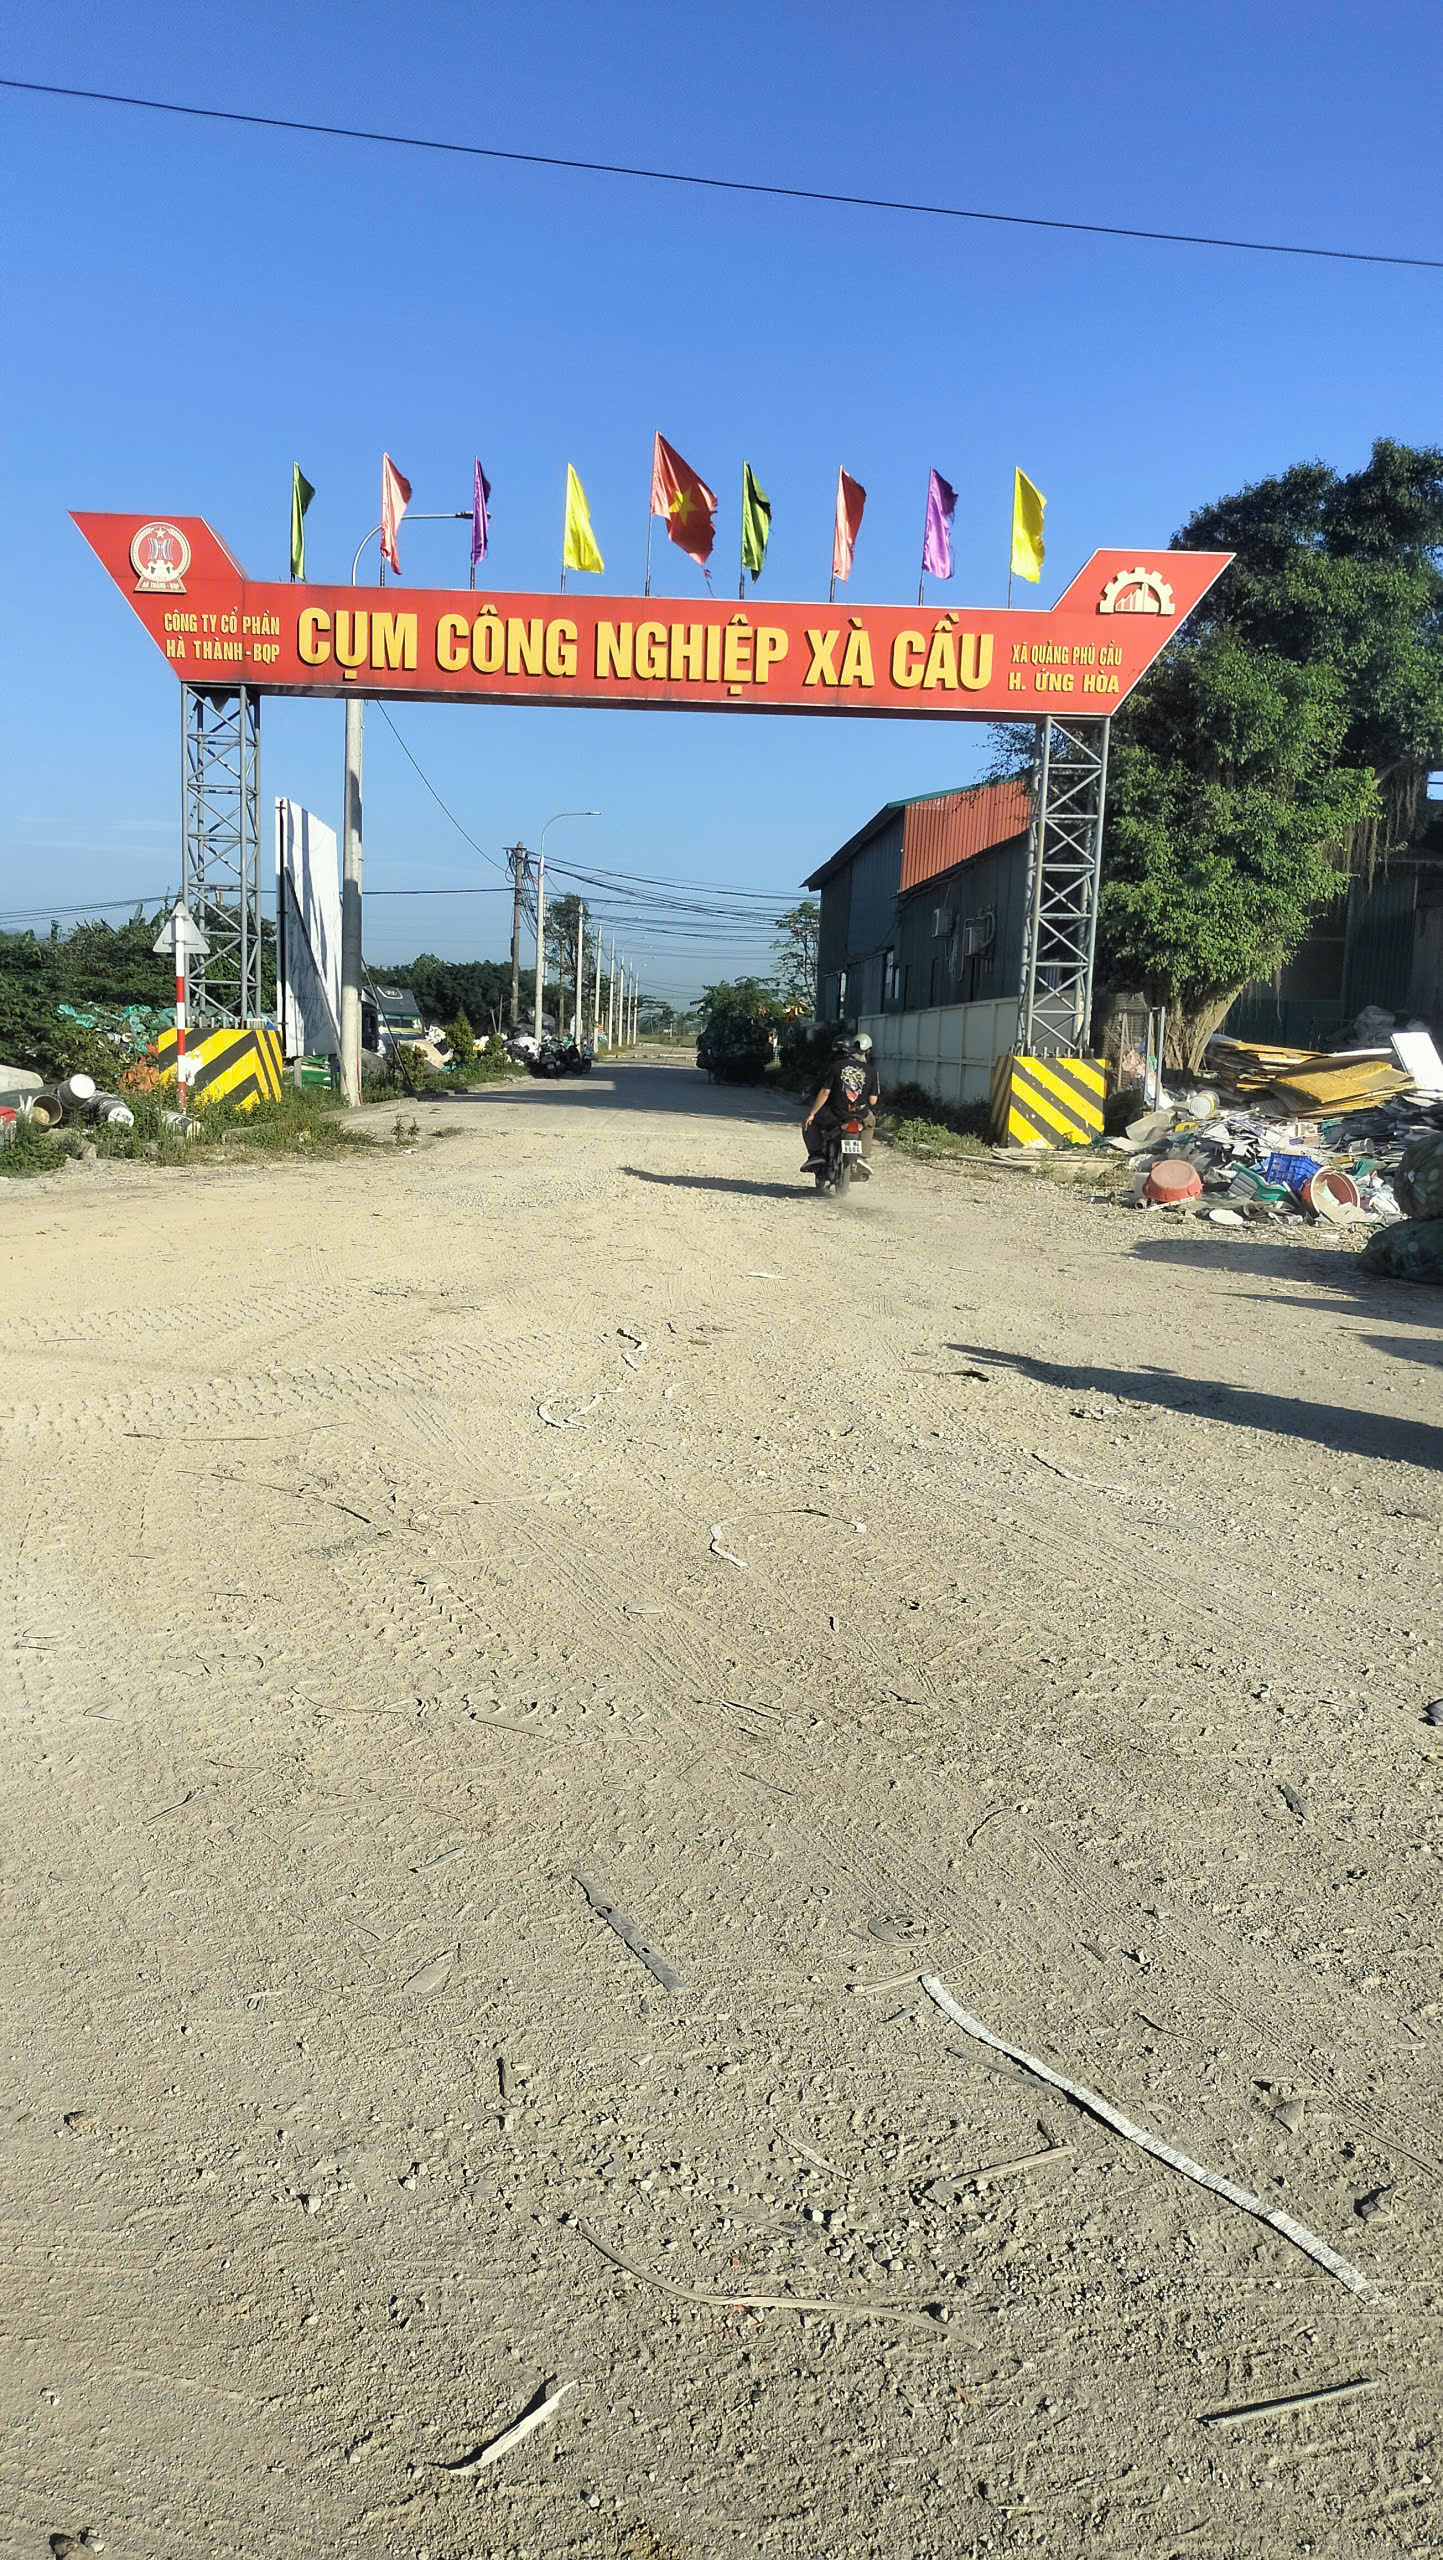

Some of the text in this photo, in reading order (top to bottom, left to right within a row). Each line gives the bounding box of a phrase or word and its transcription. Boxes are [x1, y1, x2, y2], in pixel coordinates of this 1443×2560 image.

[164, 606, 281, 635] CÔNG TY CỔ PHẦN
[166, 636, 186, 659] HÀ
[298, 604, 996, 695] CỤM CÔNG NGHIỆP XÀ CẦU
[1031, 639, 1069, 666] QUẢNG
[1072, 642, 1096, 665] PHÚ
[1099, 640, 1123, 666] CẦU
[1008, 668, 1120, 694] H. ỨNG HÒA
